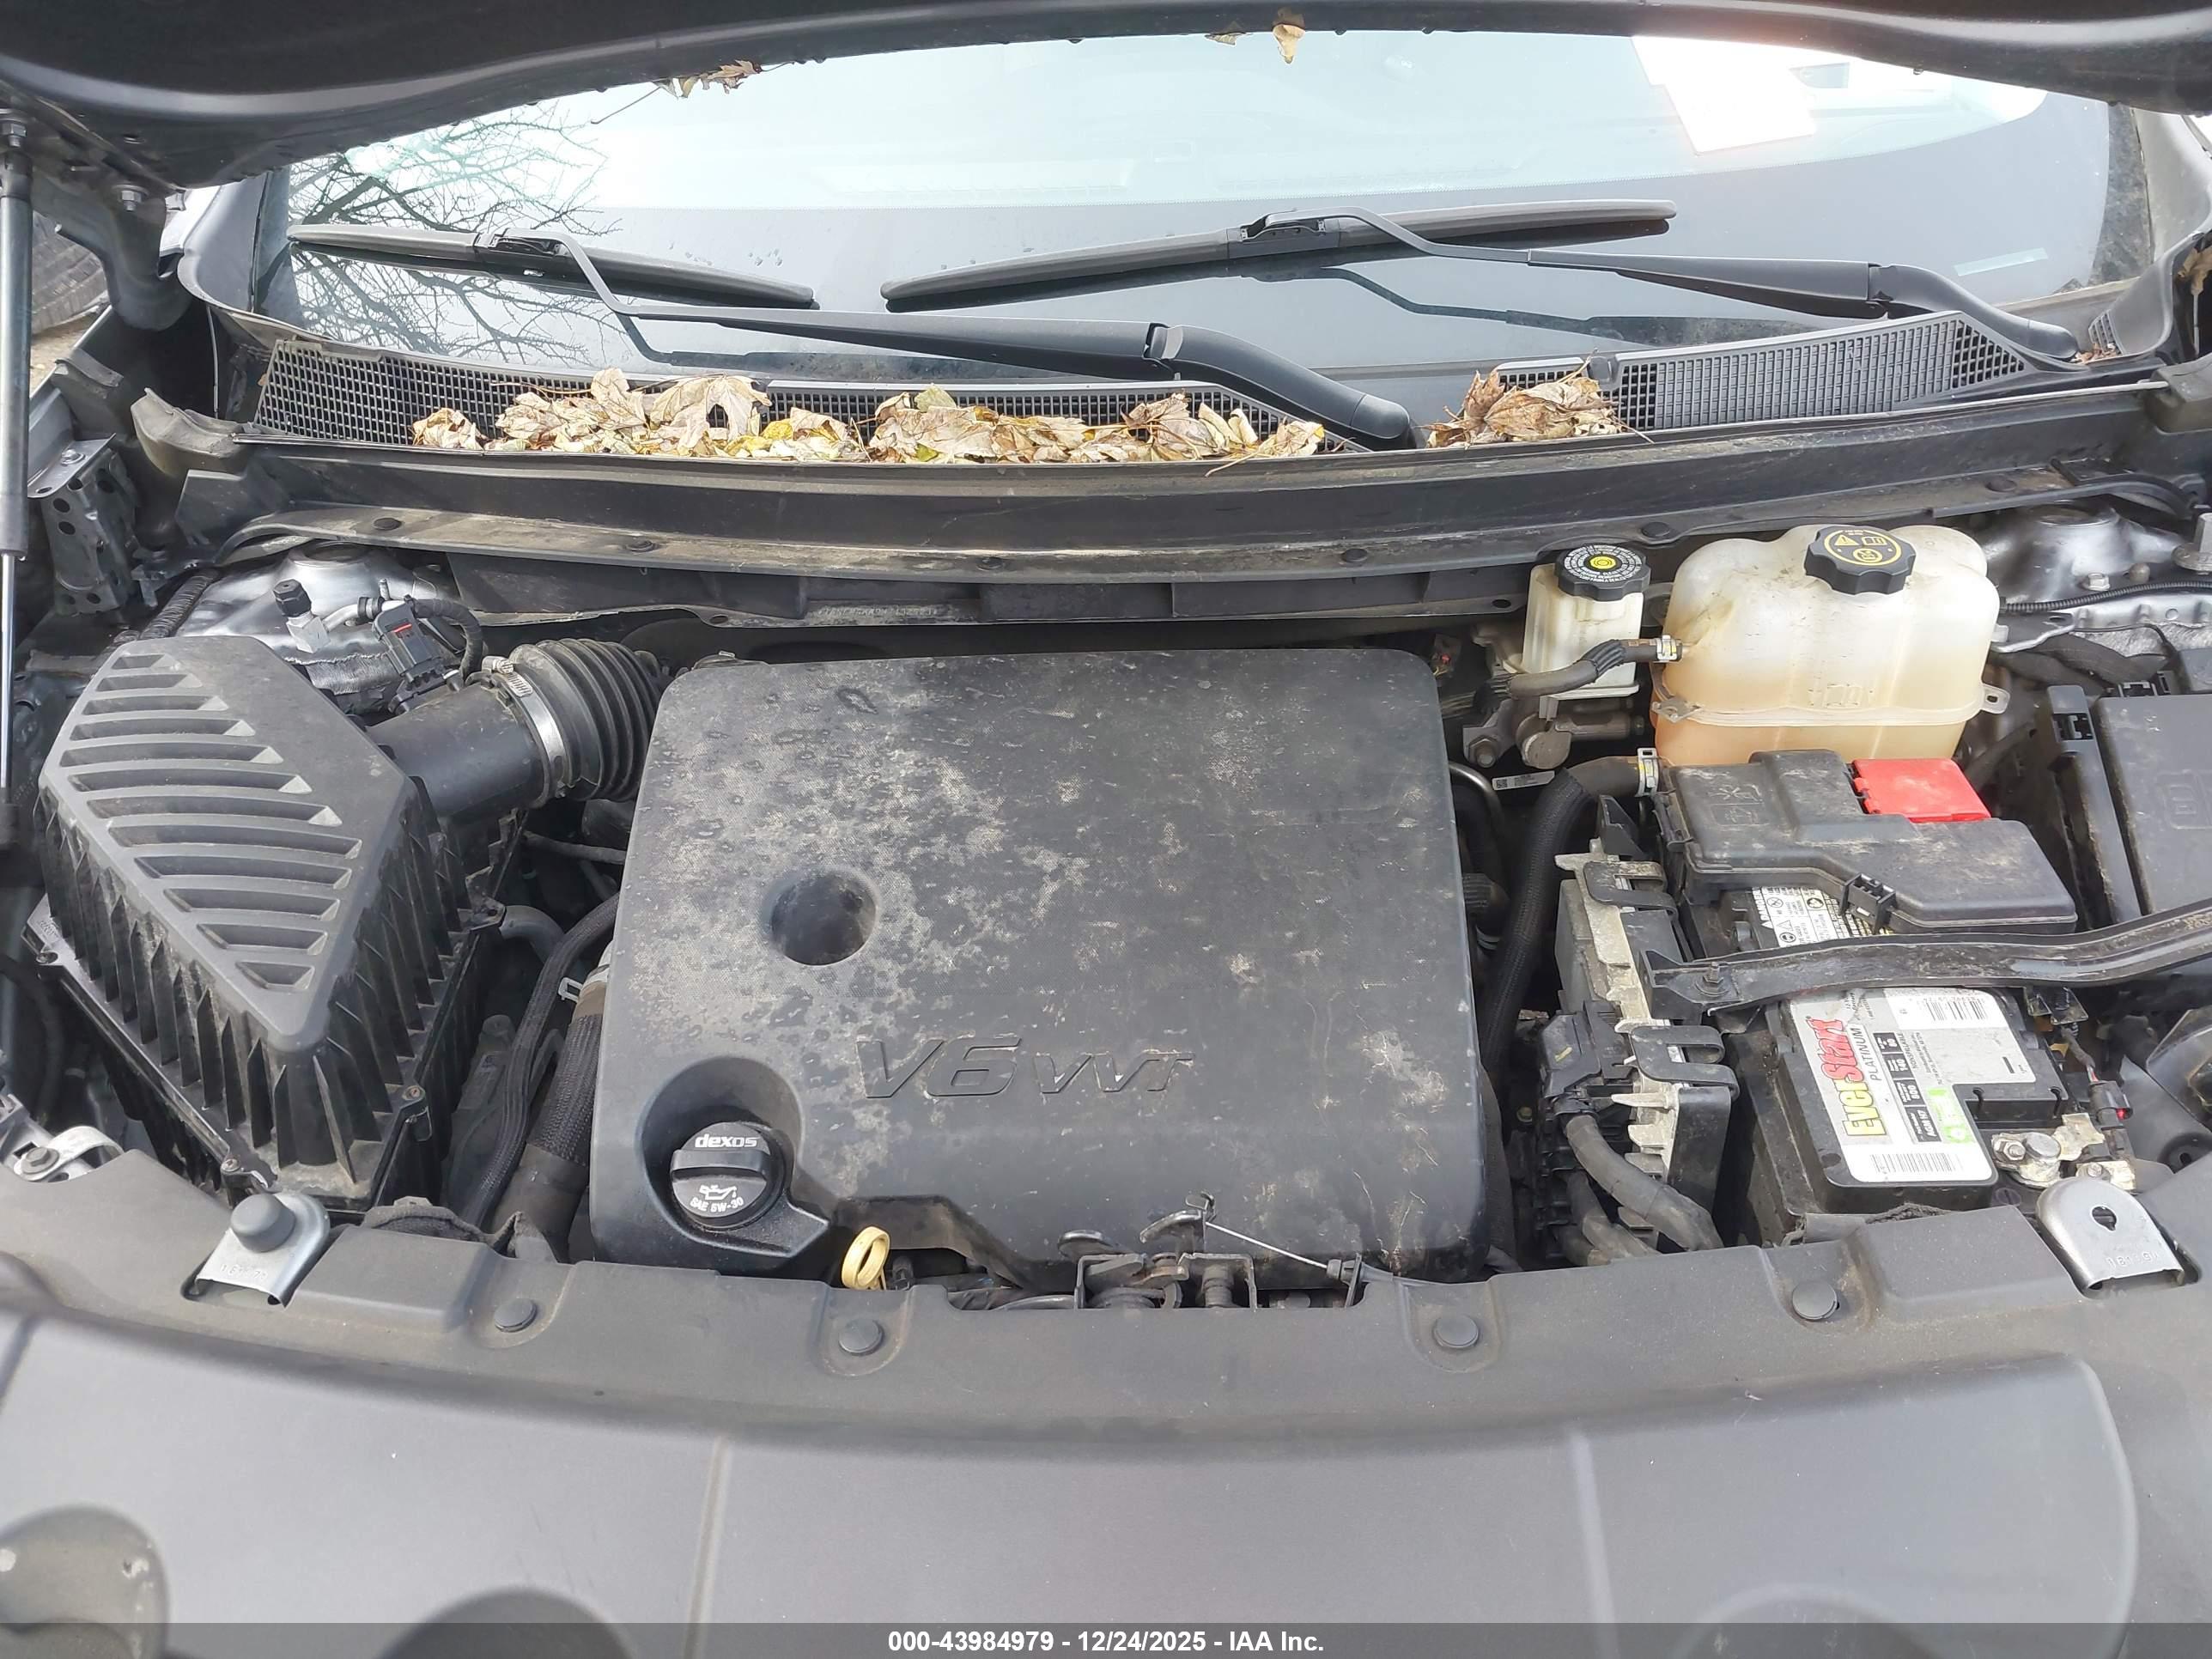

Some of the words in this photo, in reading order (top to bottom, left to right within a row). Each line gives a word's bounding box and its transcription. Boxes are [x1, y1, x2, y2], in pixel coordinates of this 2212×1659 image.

[855, 1035, 1023, 1099] V6
[1032, 1049, 1196, 1095] VVT
[1849, 1027, 1882, 1082] PLATINUM
[1806, 1018, 1887, 1136] EverStart
[694, 1133, 761, 1148] dexos
[1921, 1120, 1938, 1137] AGM
[690, 1196, 709, 1212] SAE
[710, 1196, 744, 1212] 5W-30
